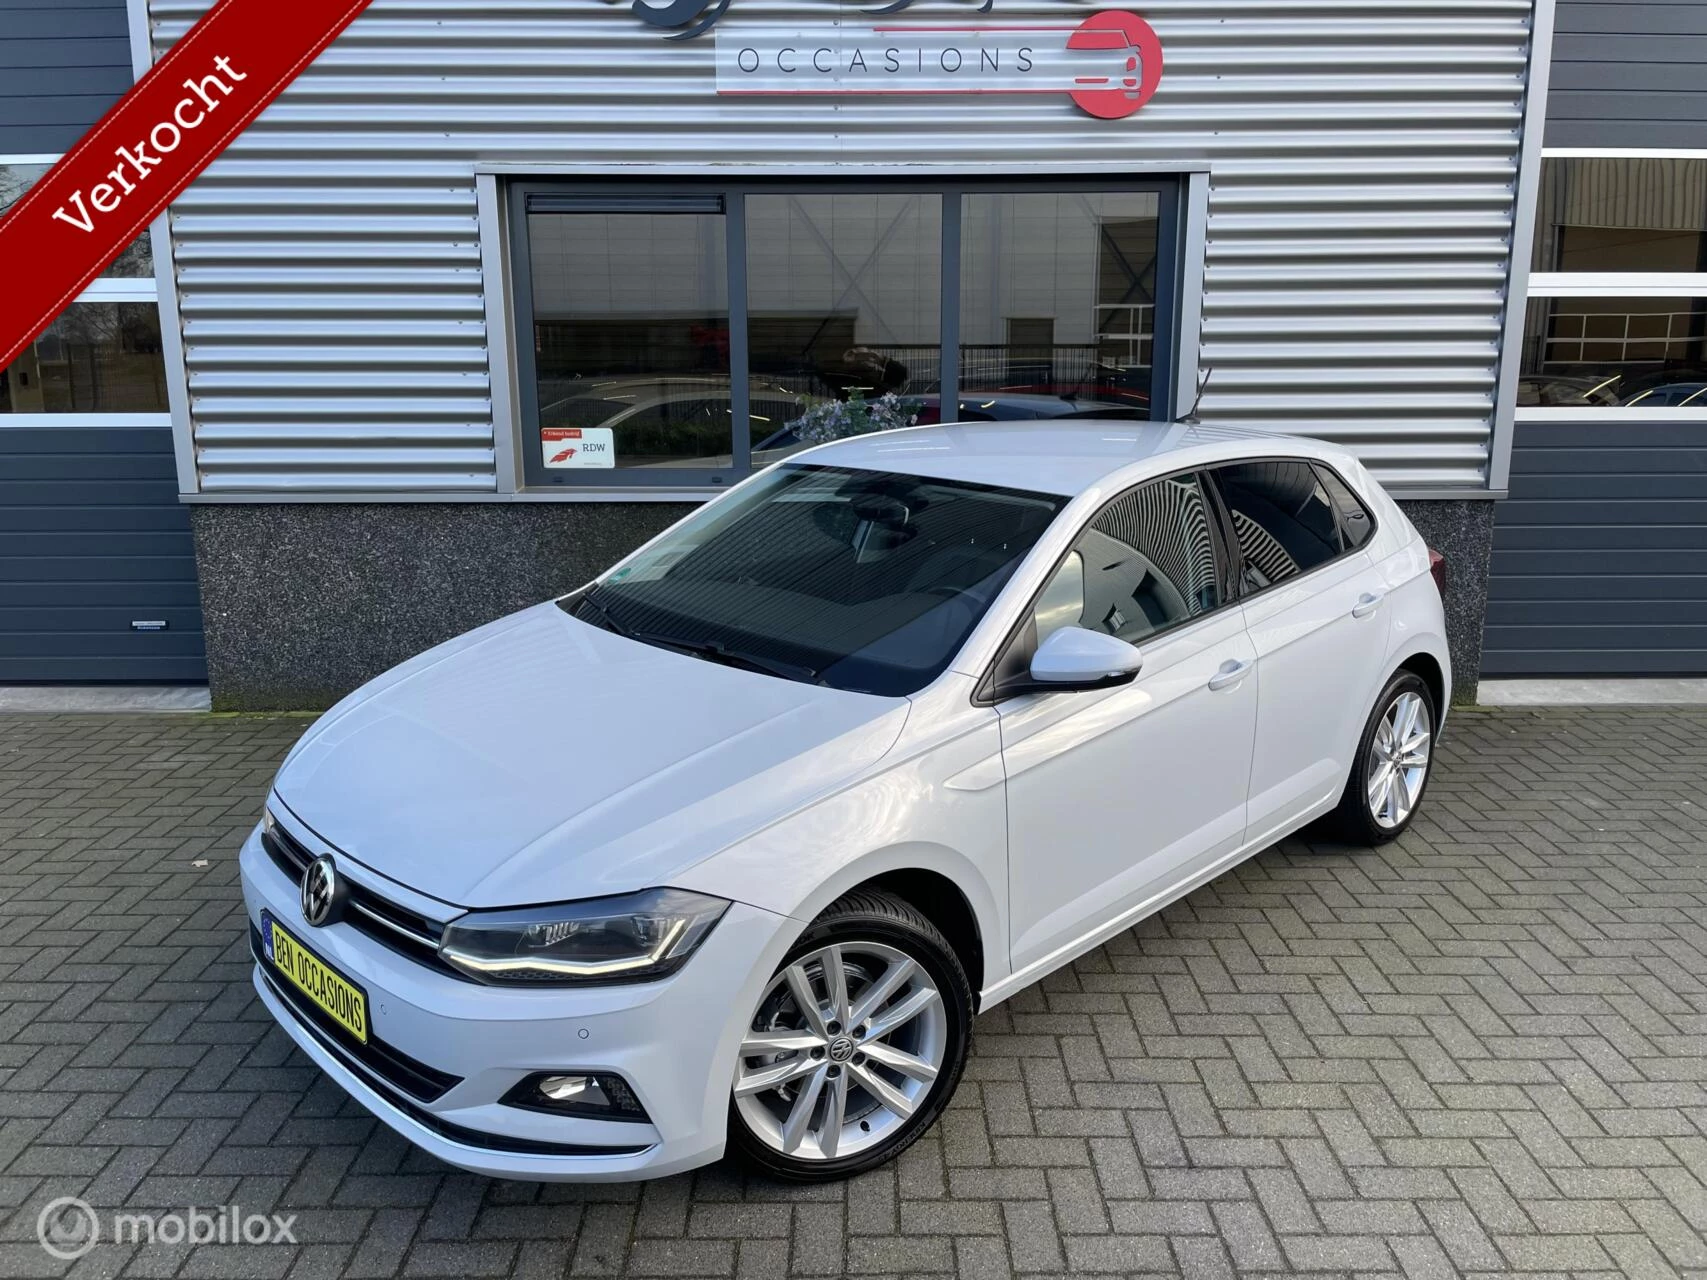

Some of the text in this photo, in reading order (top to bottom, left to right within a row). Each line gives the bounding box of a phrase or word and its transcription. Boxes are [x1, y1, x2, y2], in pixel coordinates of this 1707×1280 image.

[737, 47, 1034, 73] OCCASIONS
[582, 443, 606, 452] RDW
[274, 932, 362, 1033] BEN OCCASIONS
